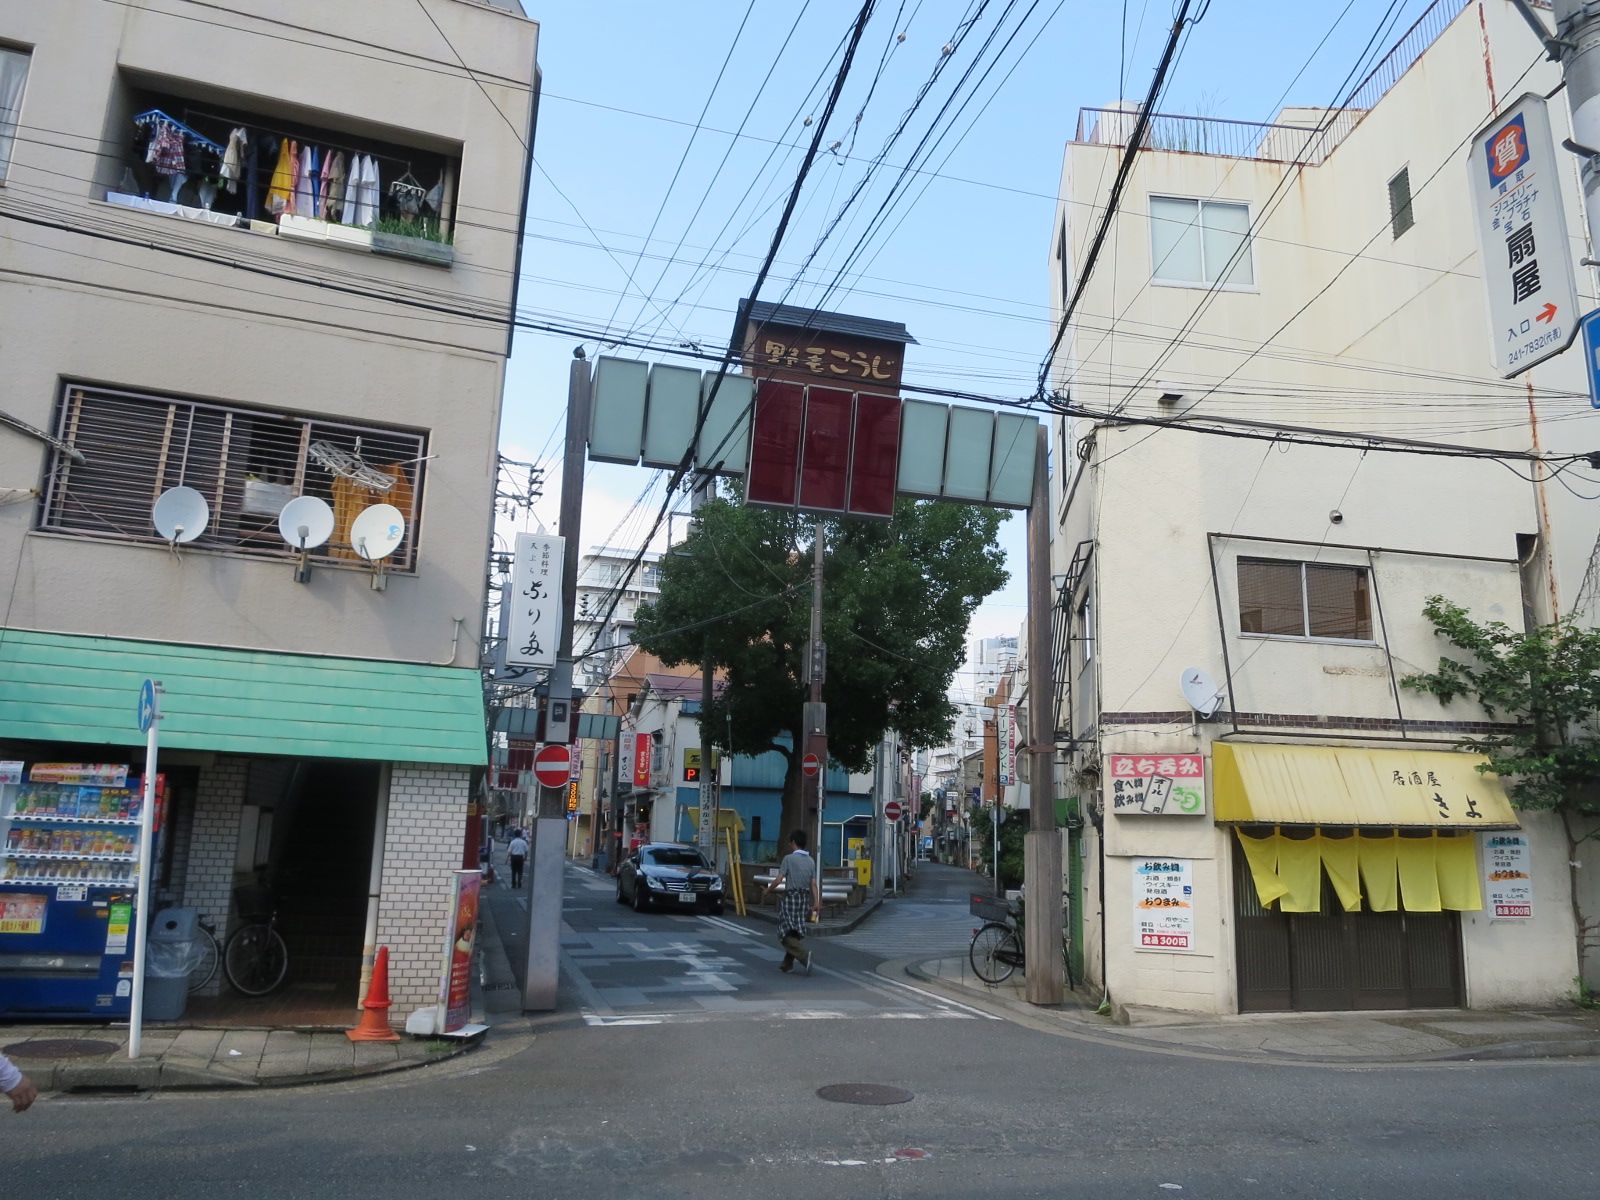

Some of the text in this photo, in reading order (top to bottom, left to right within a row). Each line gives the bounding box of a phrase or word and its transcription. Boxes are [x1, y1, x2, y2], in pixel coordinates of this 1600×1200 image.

[1495, 130, 1519, 173] 質
[1505, 221, 1542, 305] 扇屋
[1507, 318, 1531, 342] 入口
[1000, 709, 1008, 772] ソープランド
[687, 769, 696, 780] P
[1114, 757, 1199, 775] 立ち呑み
[1392, 770, 1441, 787] 居酒屋
[1433, 792, 1482, 819] きよ
